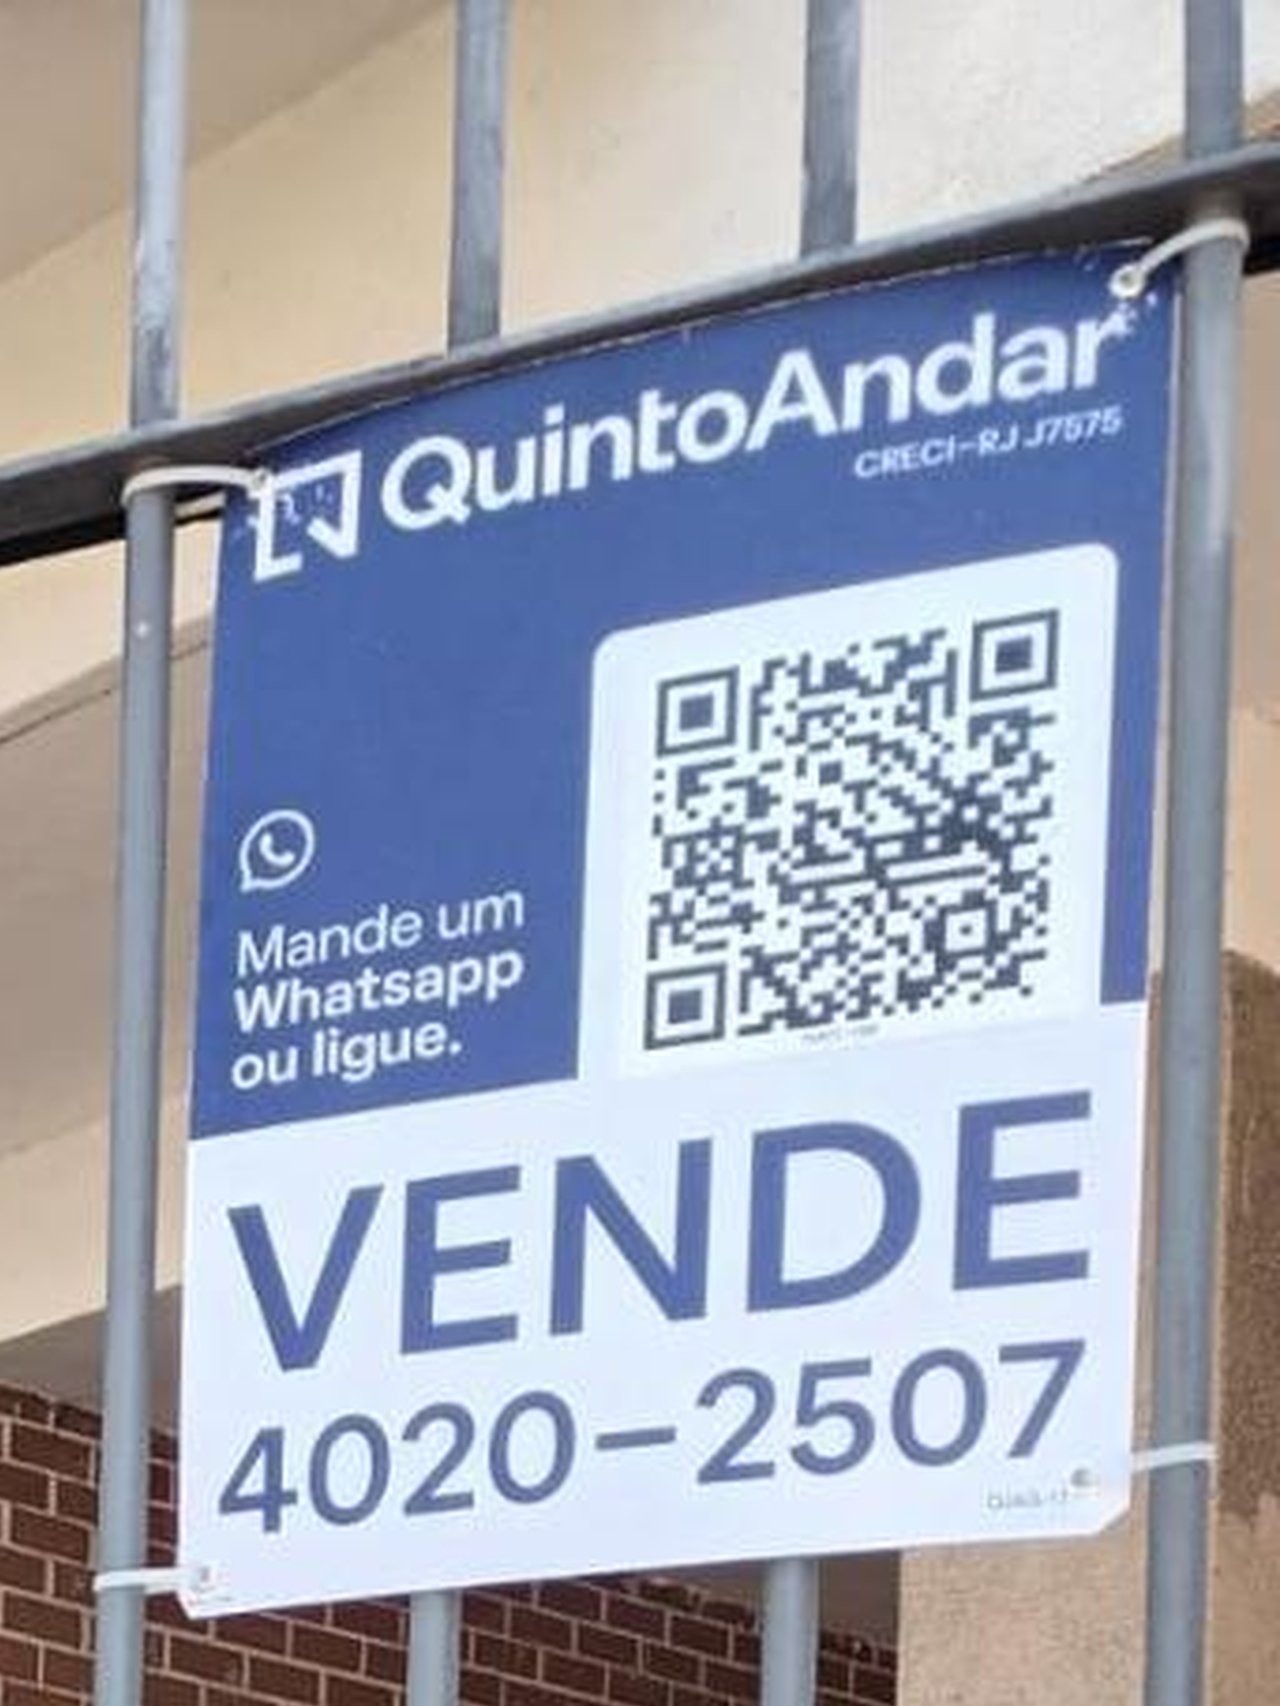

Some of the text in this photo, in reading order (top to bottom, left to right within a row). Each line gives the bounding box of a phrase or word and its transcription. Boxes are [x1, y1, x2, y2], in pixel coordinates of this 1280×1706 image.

[380, 312, 1116, 532] QuintoAndar
[854, 404, 1124, 479] CRECI-RJ J7575
[237, 889, 525, 979] Mande um
[233, 949, 525, 1034] Whatsapp
[231, 1020, 463, 1090] ou ligue.
[226, 1089, 1092, 1373] VENDE
[217, 1338, 1087, 1535] 4020-2507
